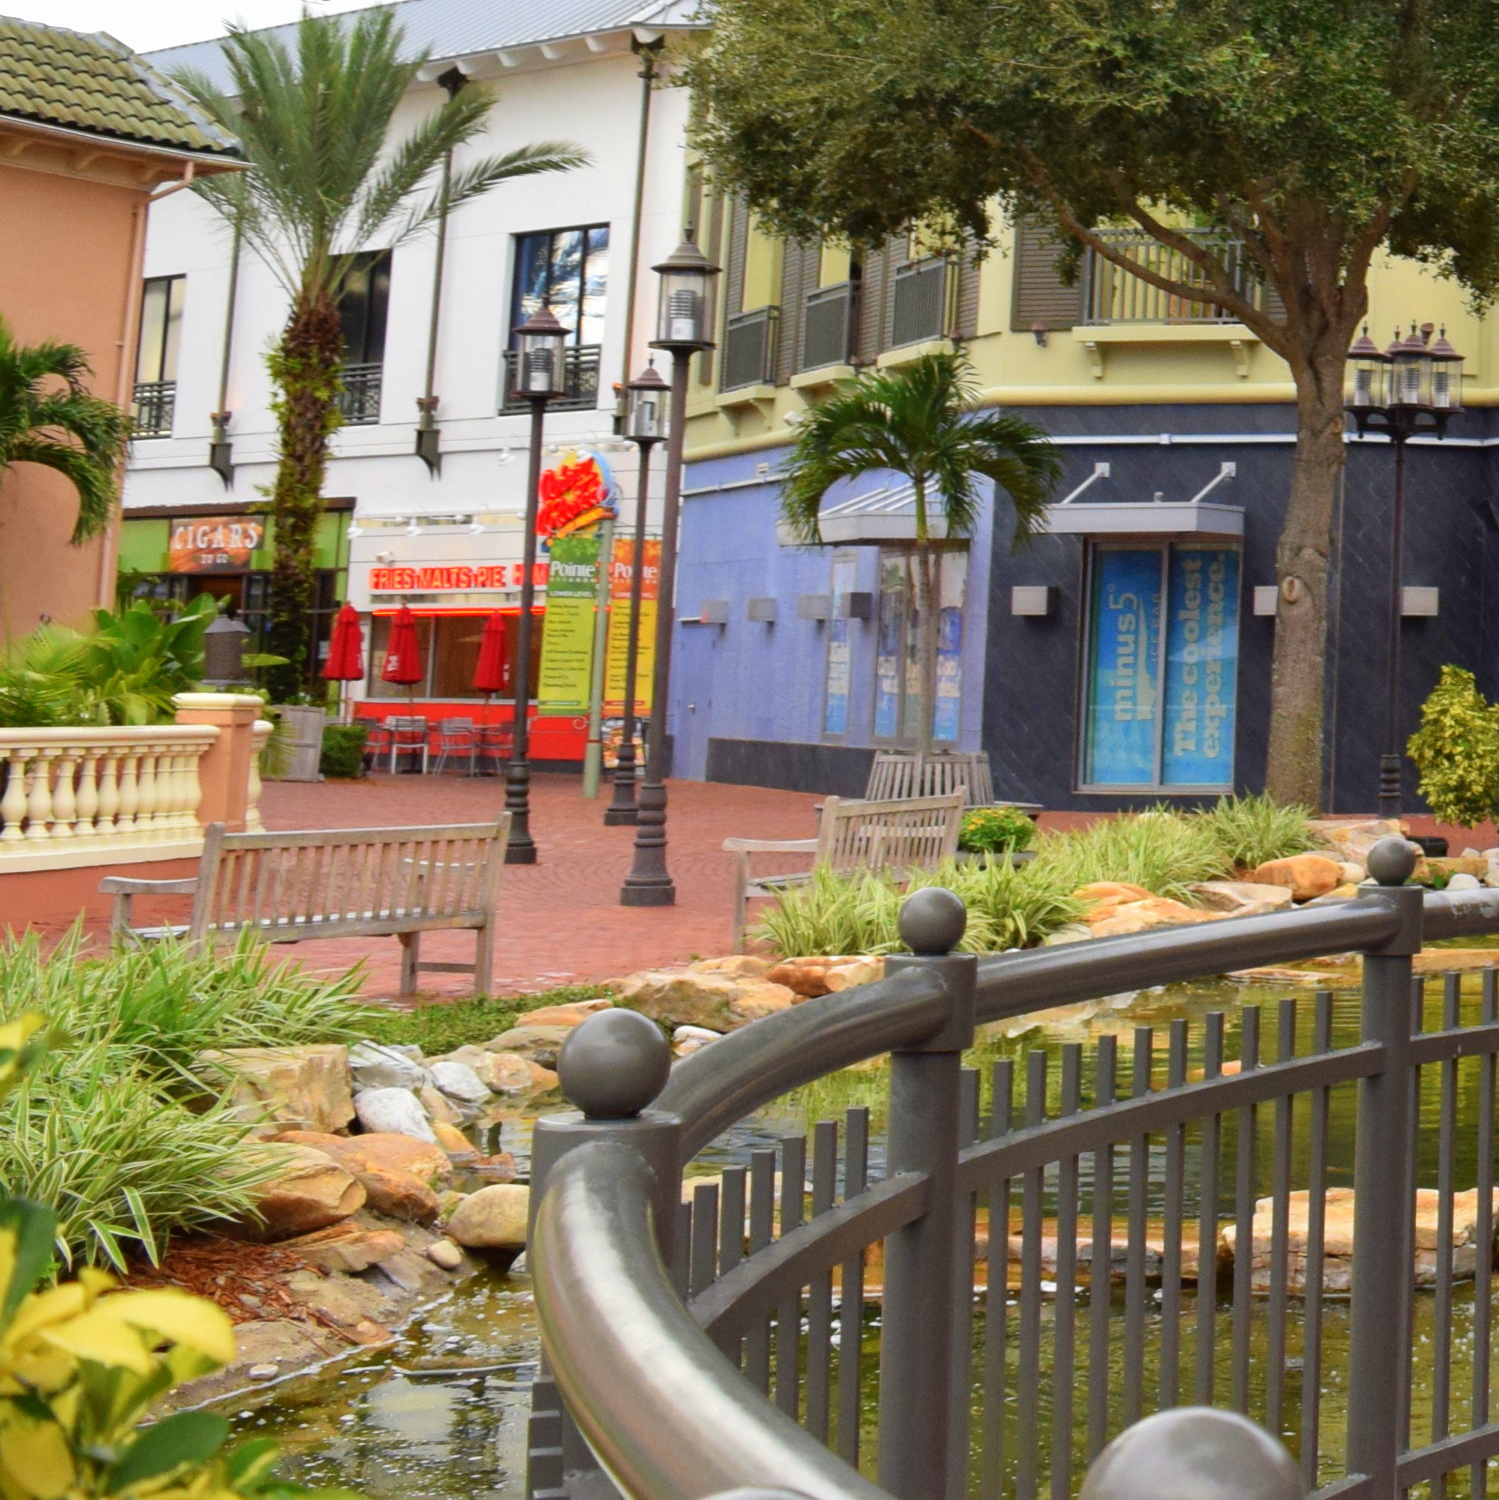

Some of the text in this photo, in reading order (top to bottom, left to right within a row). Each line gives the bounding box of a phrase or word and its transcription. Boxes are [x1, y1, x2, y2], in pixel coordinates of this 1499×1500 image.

[174, 523, 258, 549] CIGARS
[551, 560, 595, 577] Pointe
[1173, 558, 1202, 757] The coolest
